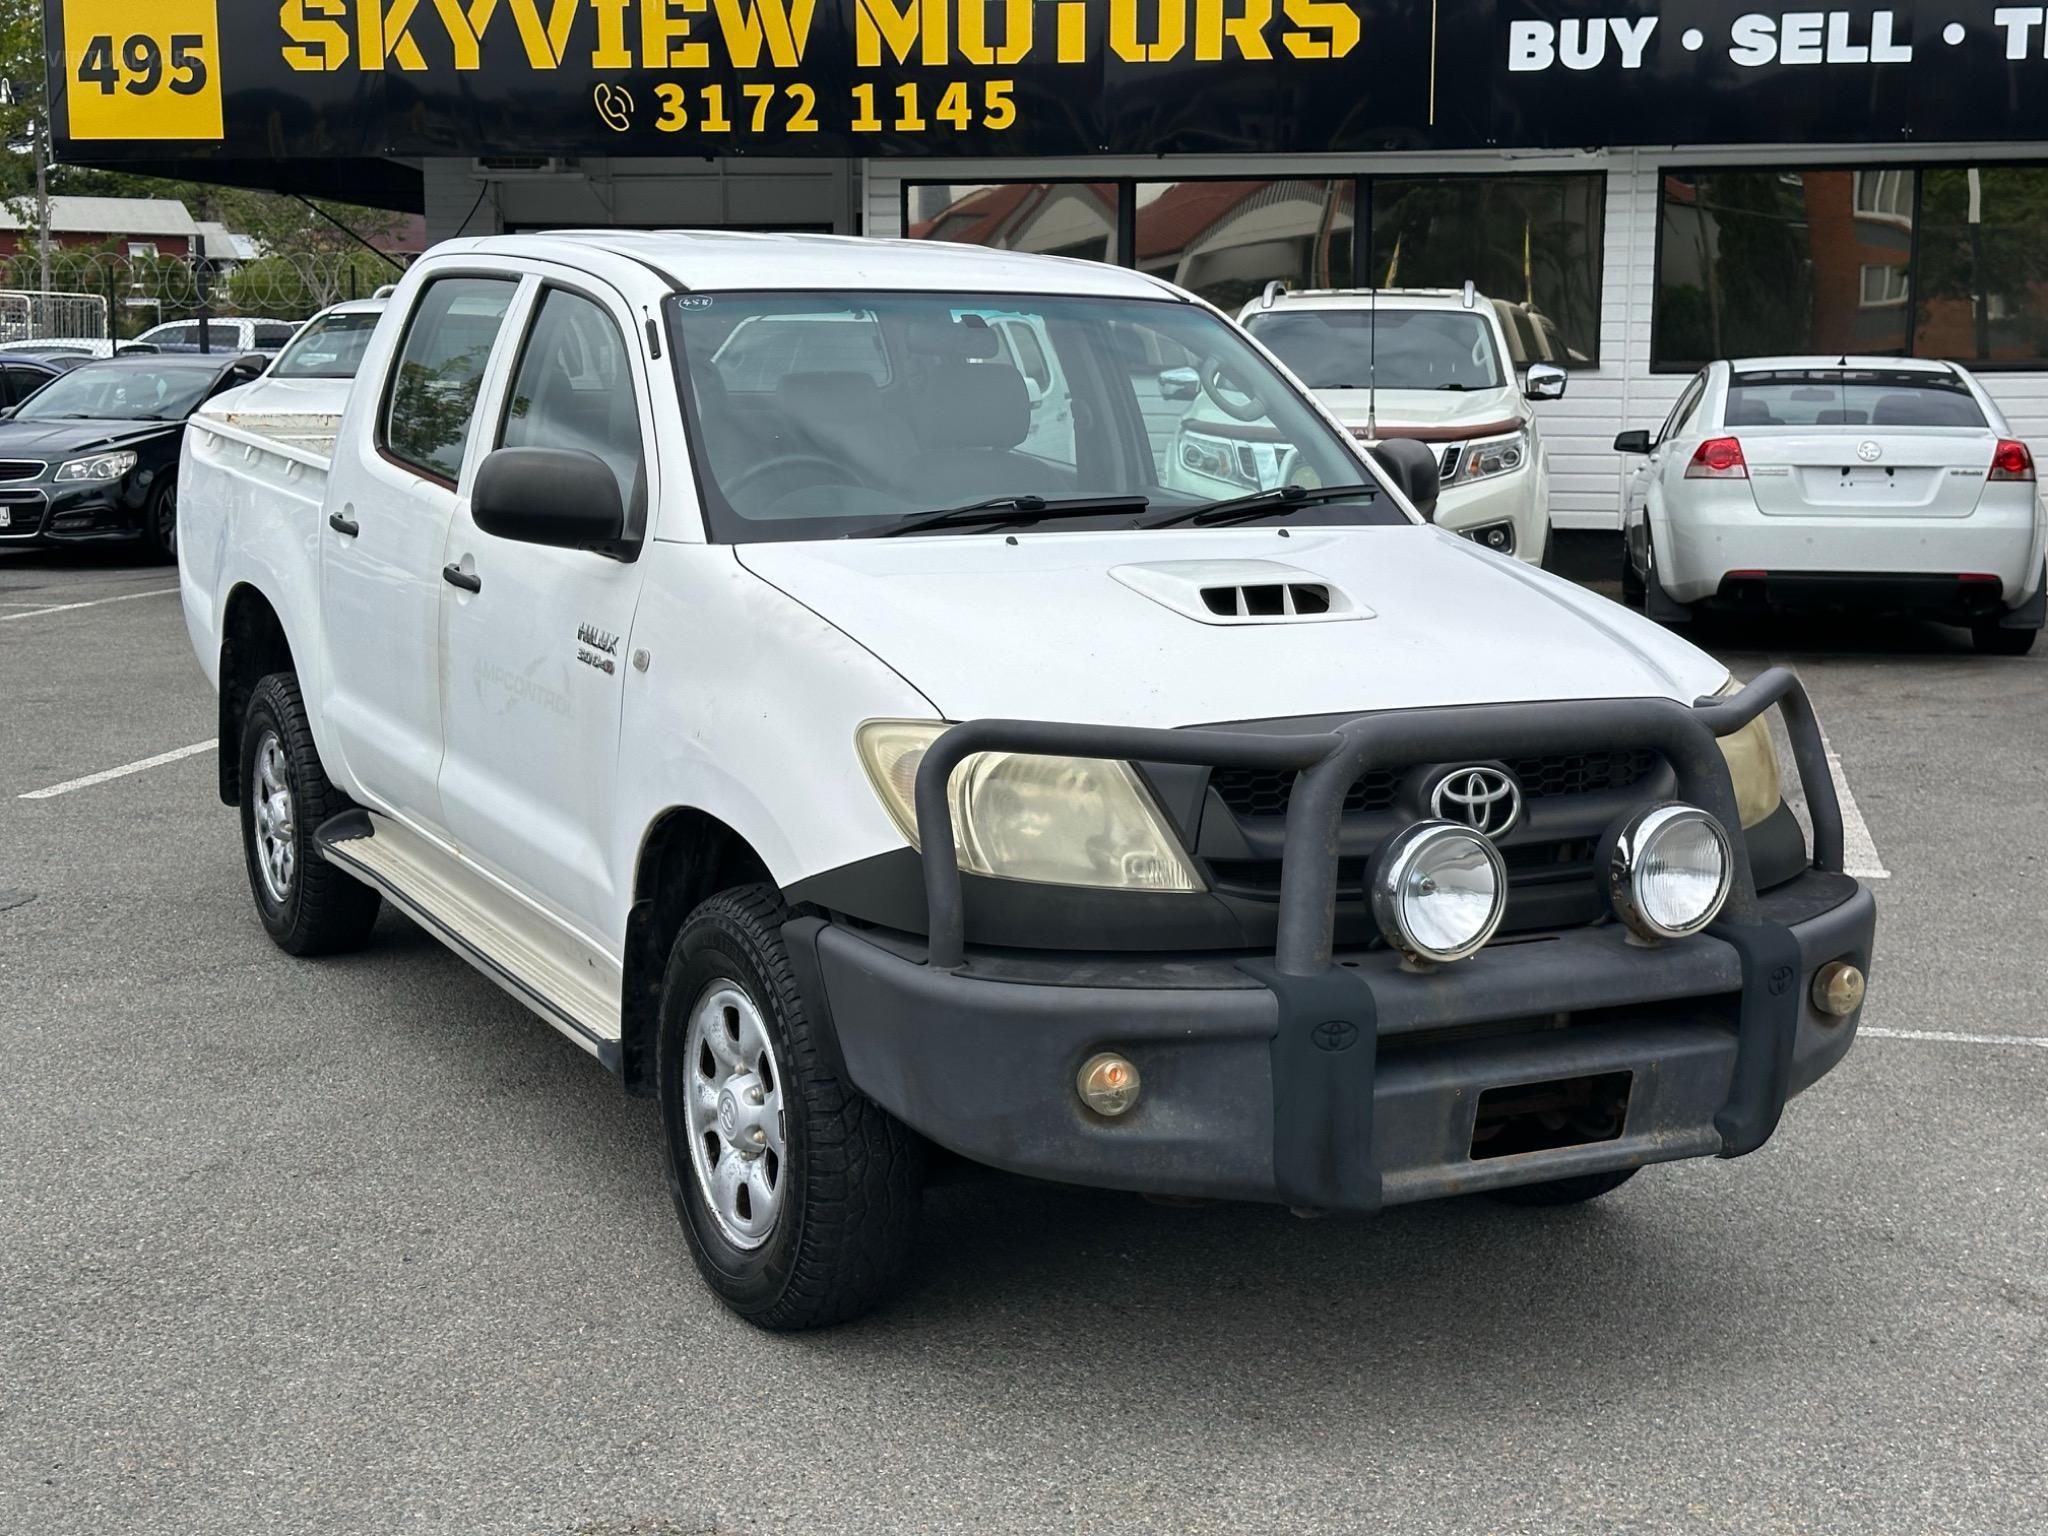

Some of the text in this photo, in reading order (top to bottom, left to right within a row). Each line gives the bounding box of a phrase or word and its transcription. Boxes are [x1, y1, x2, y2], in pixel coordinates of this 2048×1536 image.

[78, 34, 208, 95] 495
[280, 0, 1361, 71] SKYVIEW MOTORS
[1508, 7, 2048, 71] BUY SELL T
[654, 80, 1017, 132] 3172 1145
[577, 621, 620, 657] HILUX
